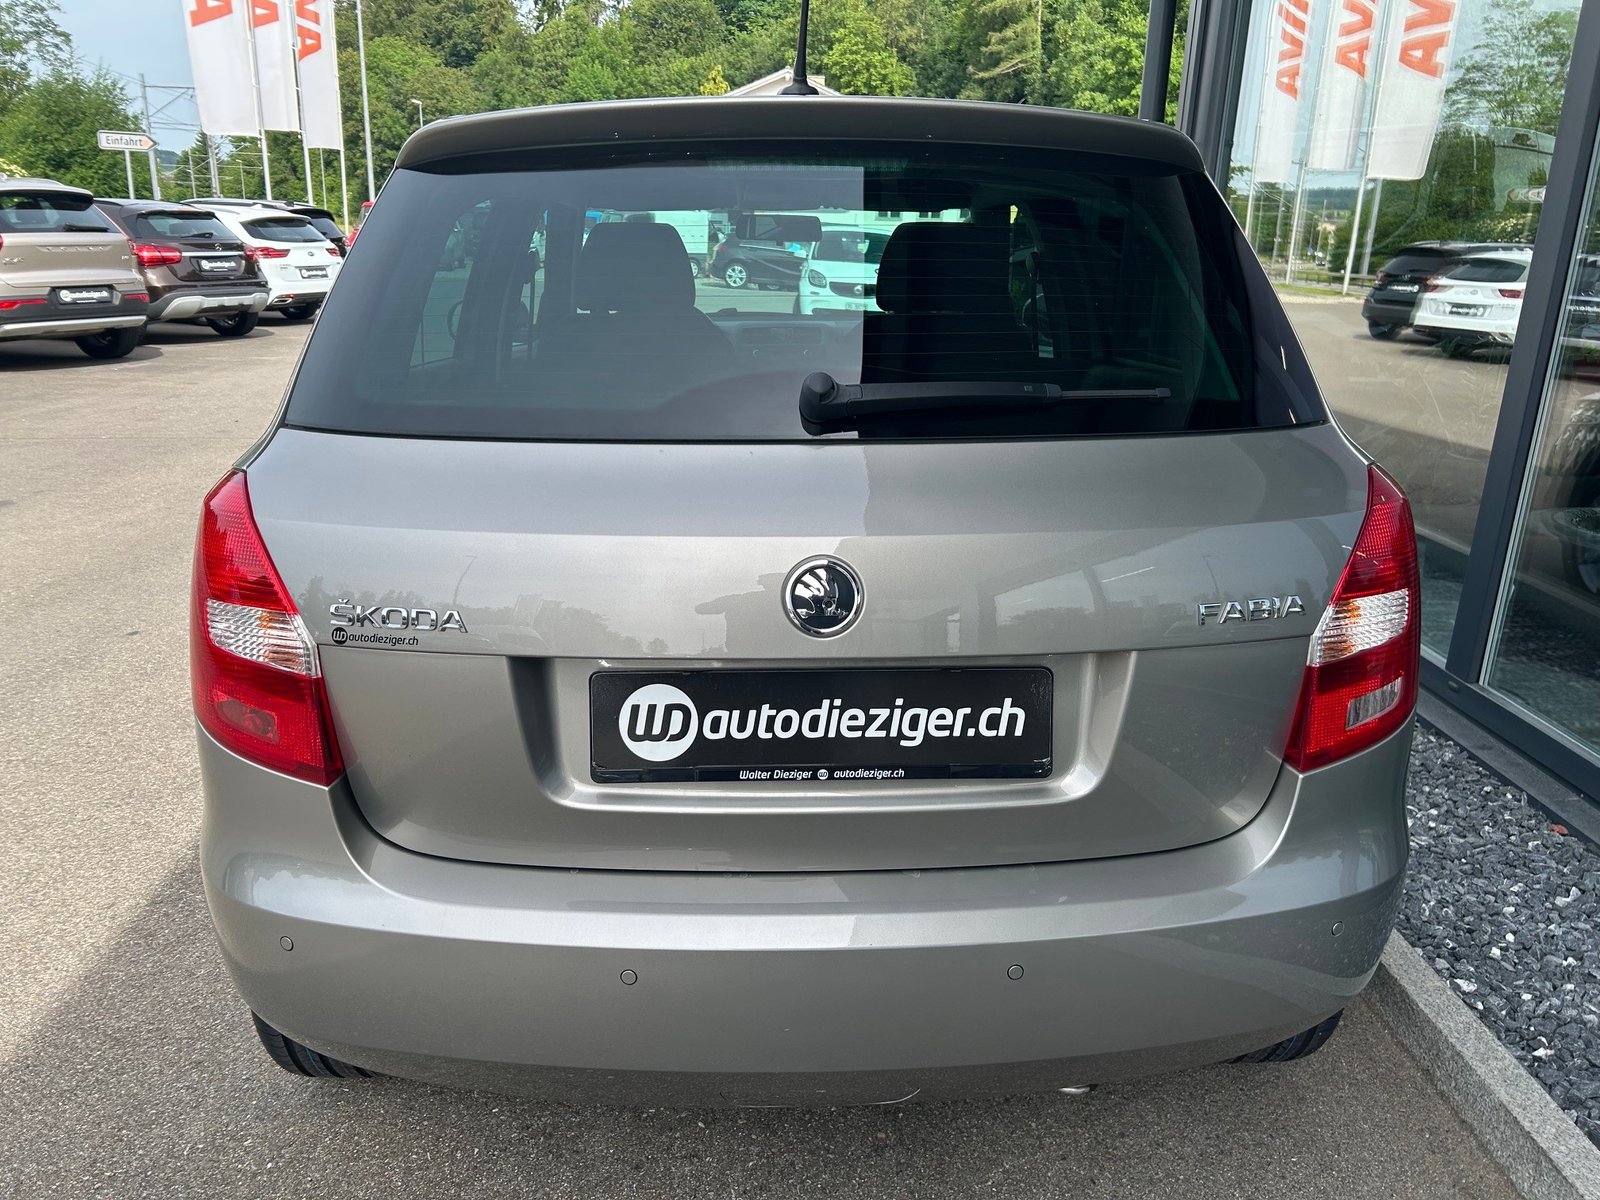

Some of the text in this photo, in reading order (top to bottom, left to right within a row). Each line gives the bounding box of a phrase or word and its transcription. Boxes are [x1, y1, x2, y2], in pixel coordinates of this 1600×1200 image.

[105, 135, 144, 147] Einfahrt
[329, 598, 468, 633] ŠKODA
[1198, 594, 1306, 626] FABIA
[348, 633, 419, 647] autodieziger.ch
[702, 697, 1026, 747] autodieziger.ch
[739, 769, 771, 780] Walter
[773, 769, 813, 781] Dieziger
[834, 768, 905, 780] autodieziger.ch
